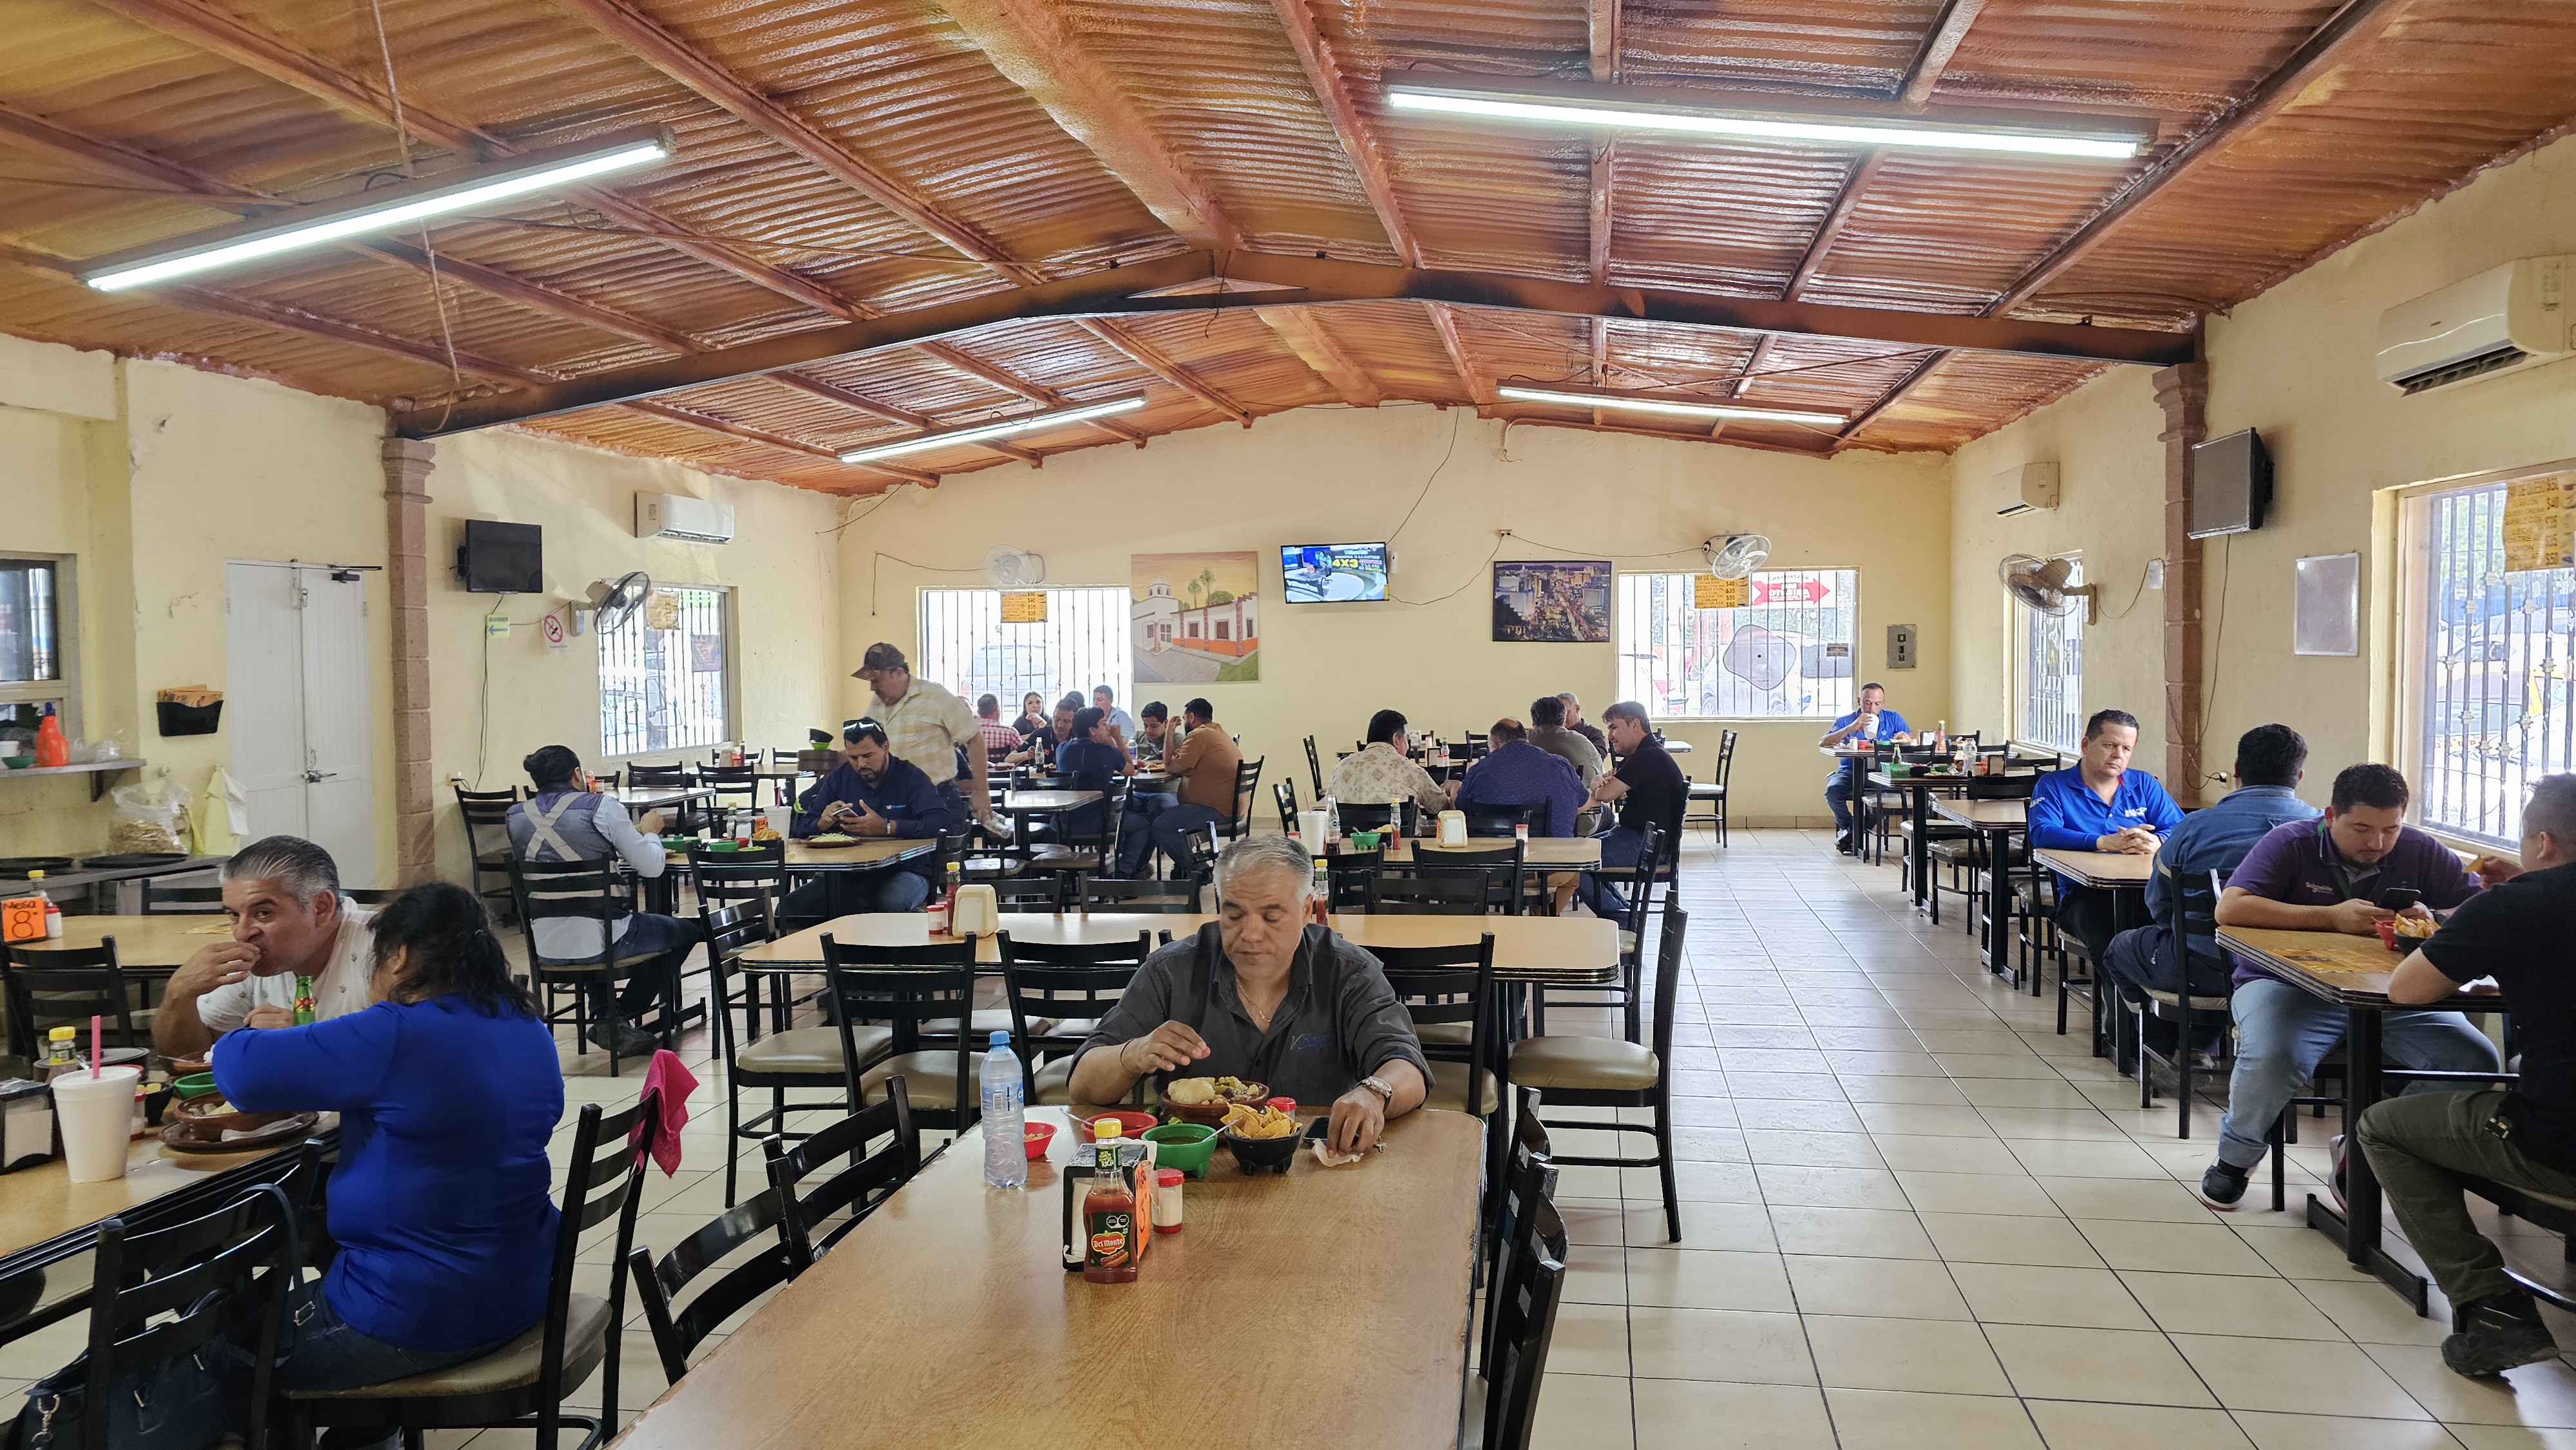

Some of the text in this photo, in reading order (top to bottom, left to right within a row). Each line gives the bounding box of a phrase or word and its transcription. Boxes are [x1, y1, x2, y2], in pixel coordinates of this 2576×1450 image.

[1332, 558, 1359, 568] 4X3
[3, 901, 37, 910] Mesa
[12, 910, 34, 939] 8
[1101, 1159, 1114, 1167] RICA
[1103, 1238, 1124, 1247] Monte
